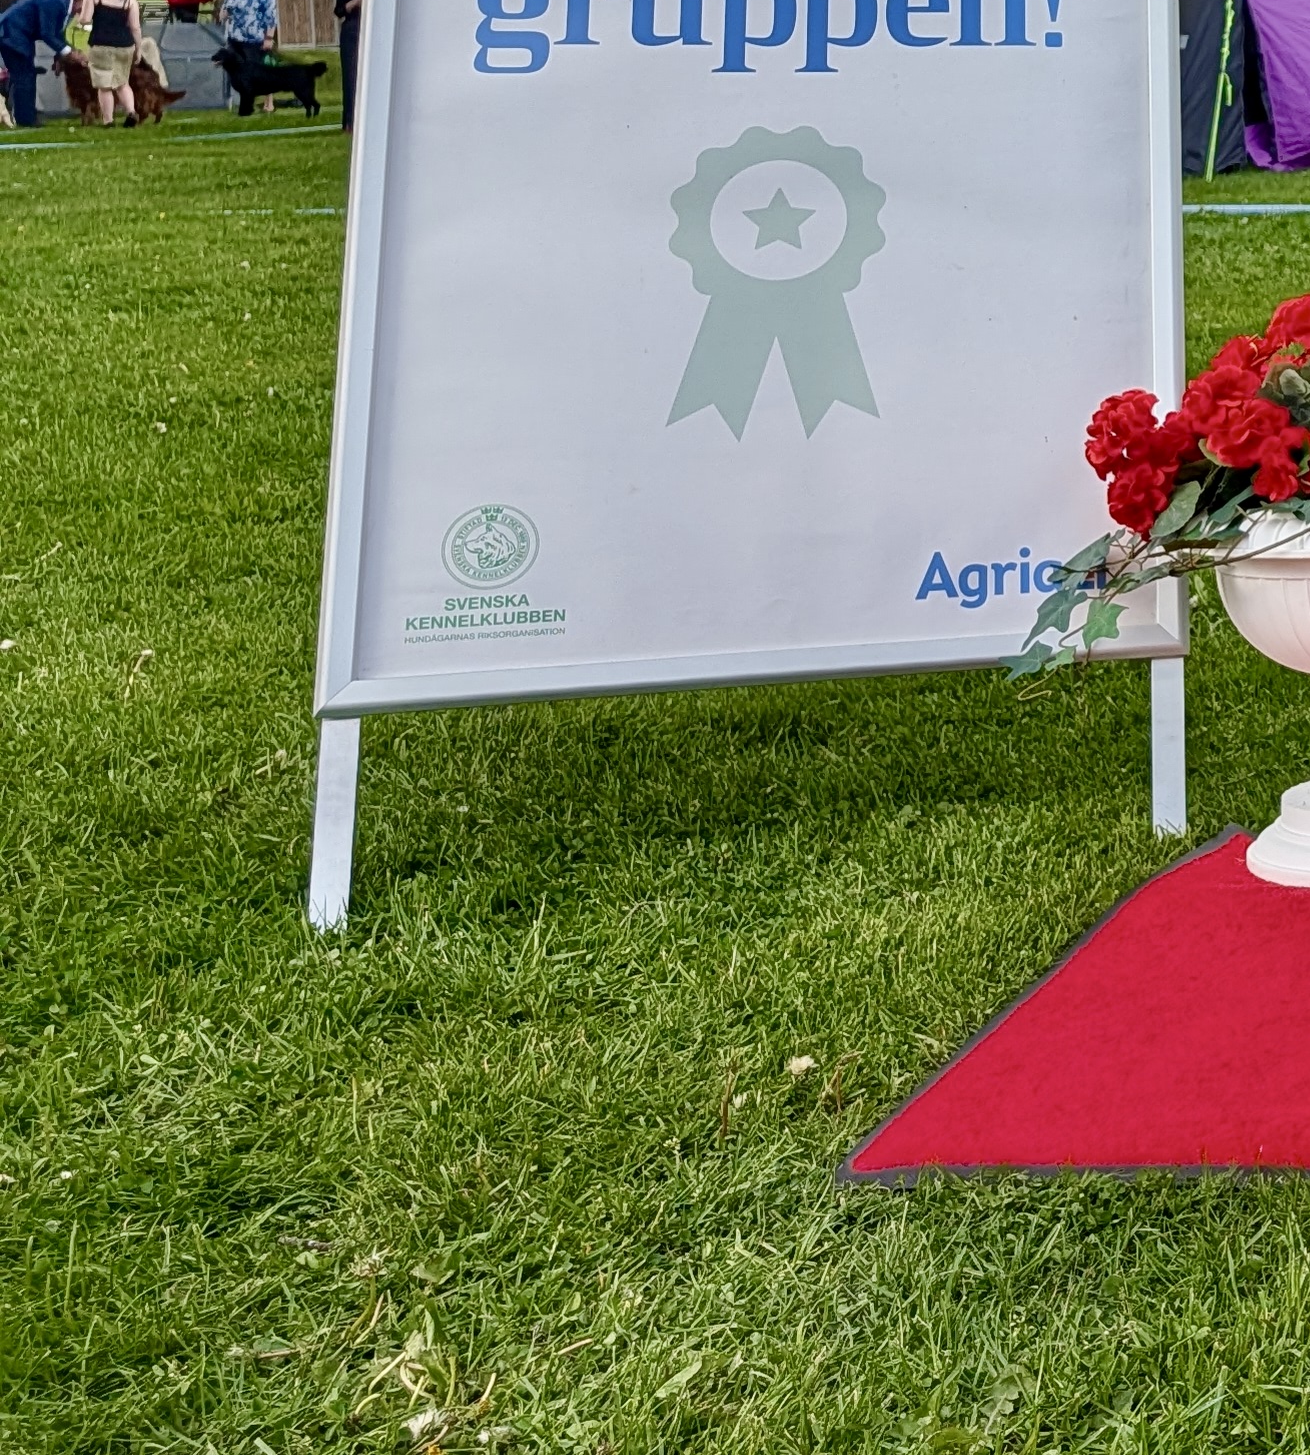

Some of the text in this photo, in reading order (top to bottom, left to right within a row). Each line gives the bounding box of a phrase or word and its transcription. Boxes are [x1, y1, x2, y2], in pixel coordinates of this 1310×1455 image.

[444, 594, 530, 611] SVENSKA
[405, 609, 567, 630] KENNELKLUBBEN
[477, 627, 566, 639] RIKSORGANISATION
